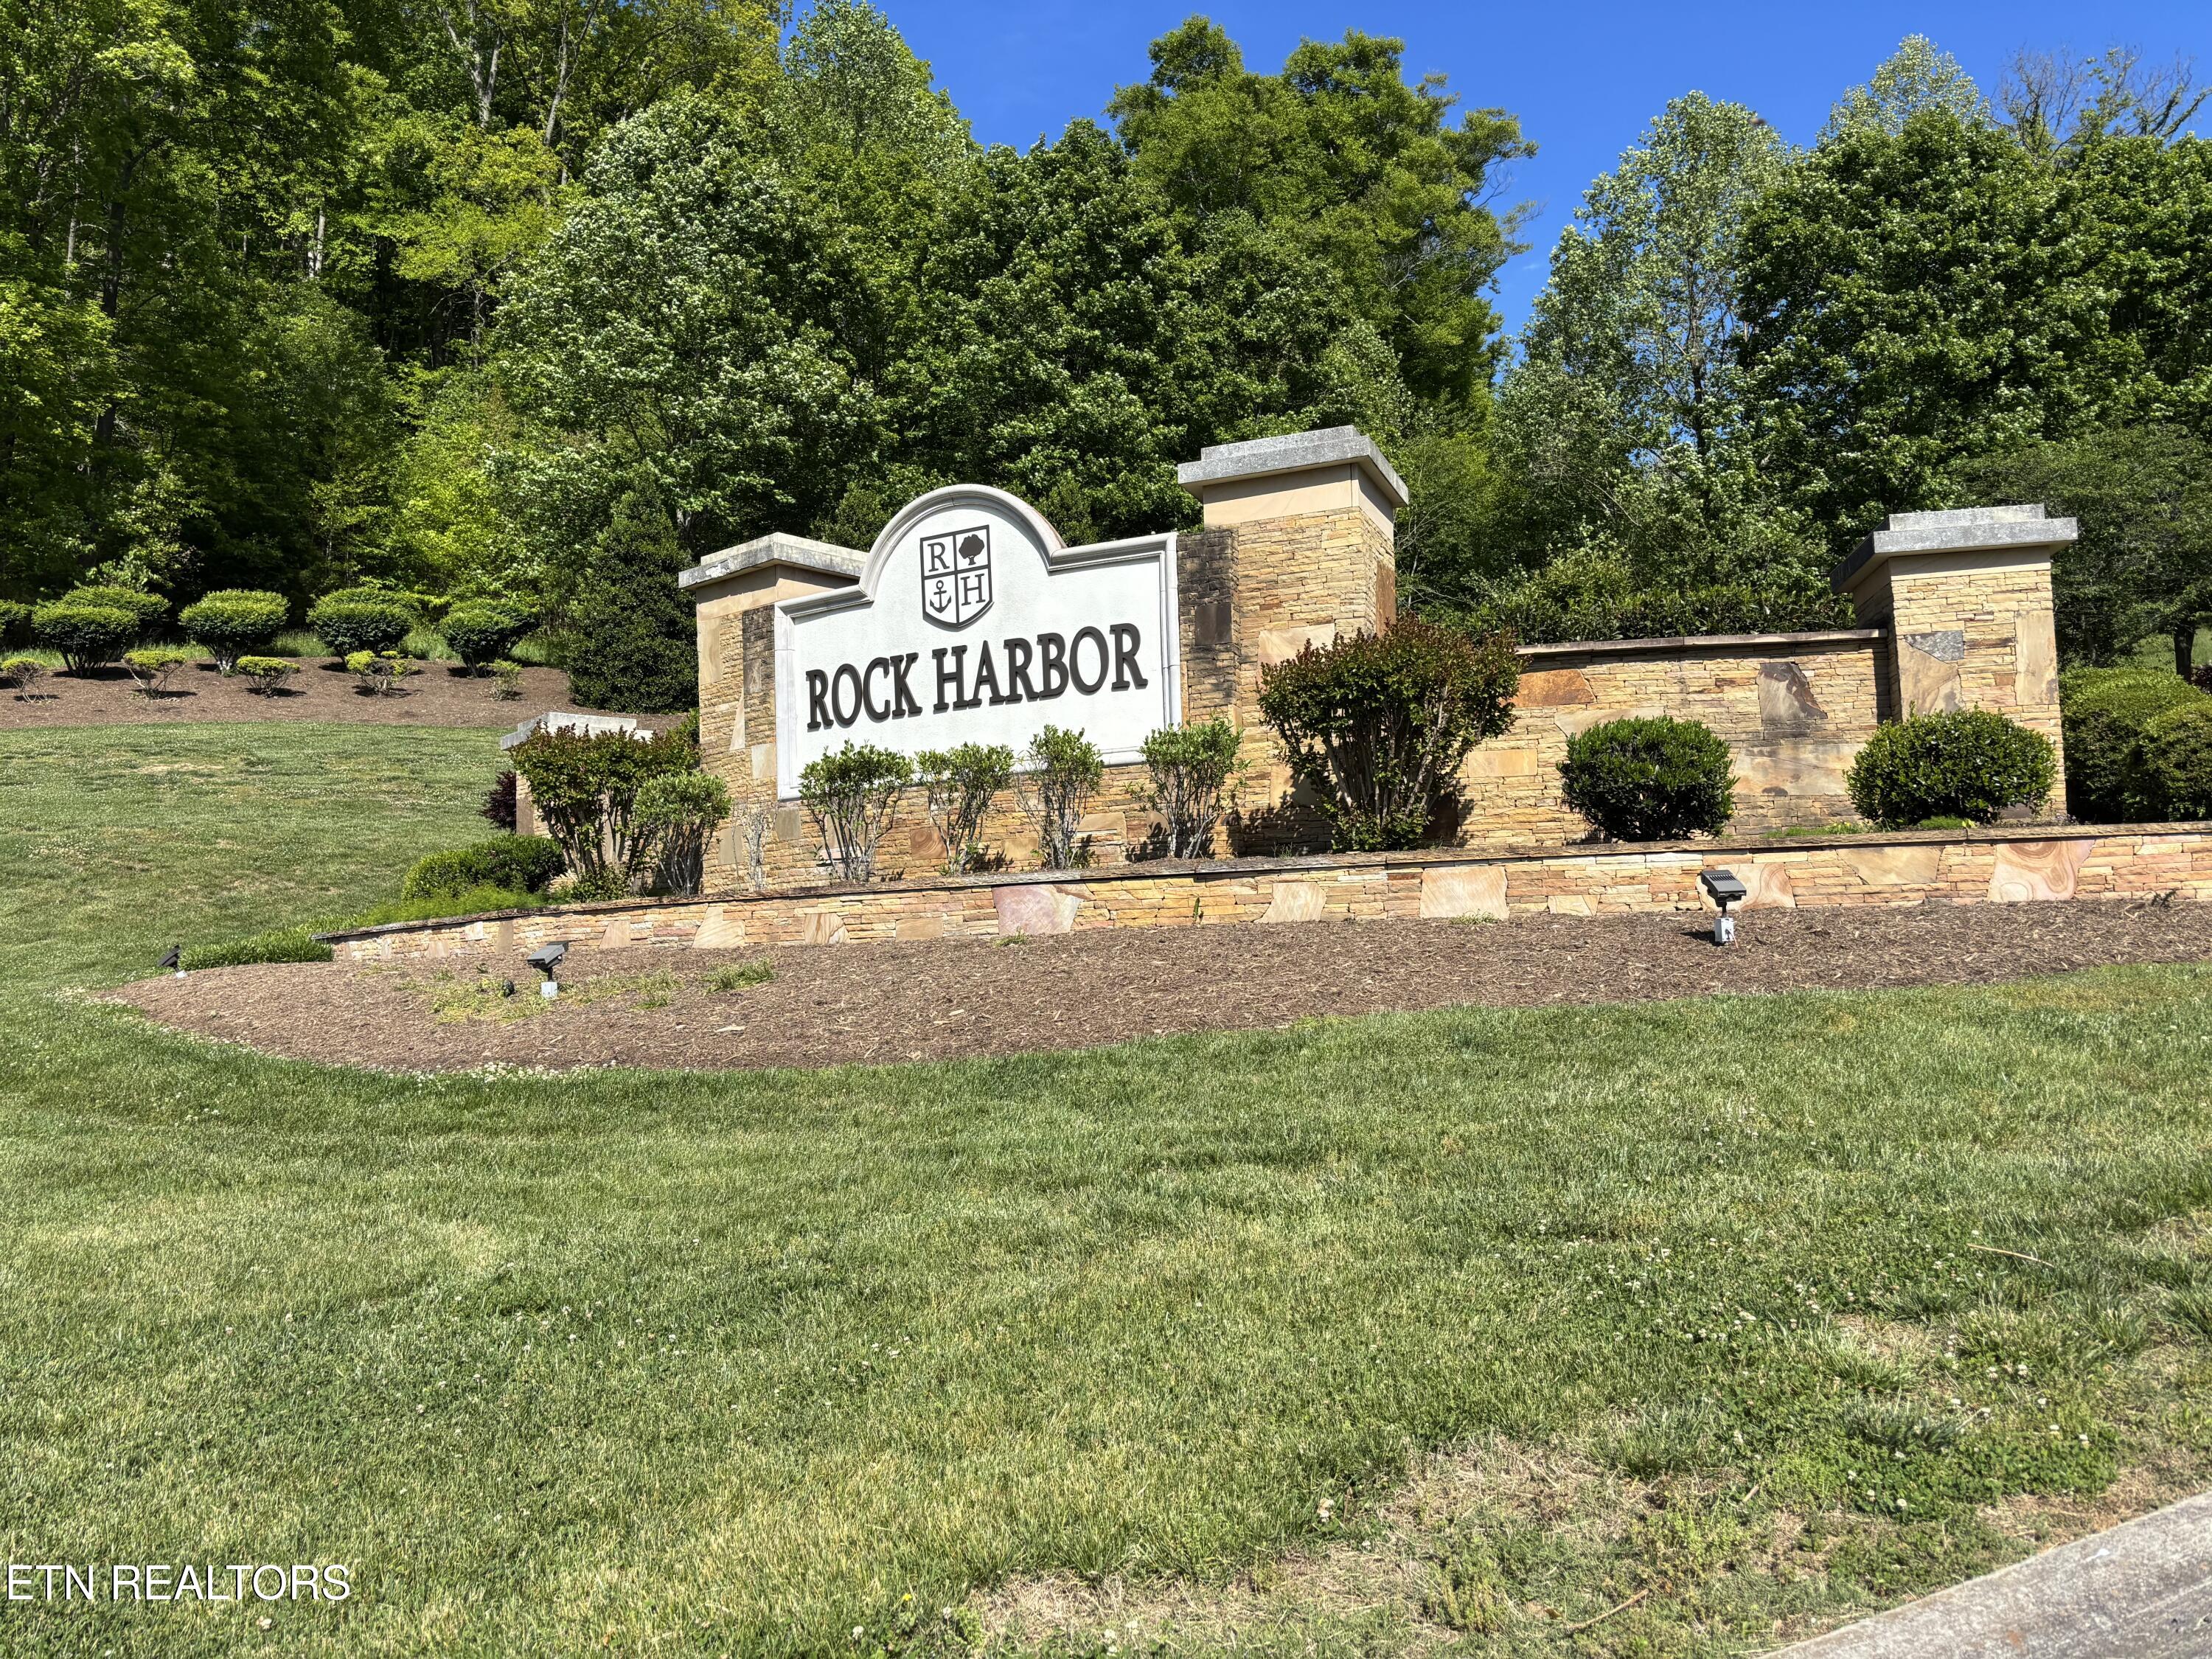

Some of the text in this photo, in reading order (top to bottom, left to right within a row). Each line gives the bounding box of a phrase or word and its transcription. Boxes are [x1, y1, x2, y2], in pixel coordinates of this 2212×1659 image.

[927, 542, 950, 573] R
[960, 573, 986, 606] H
[805, 622, 1149, 731] ROCK HARBOR
